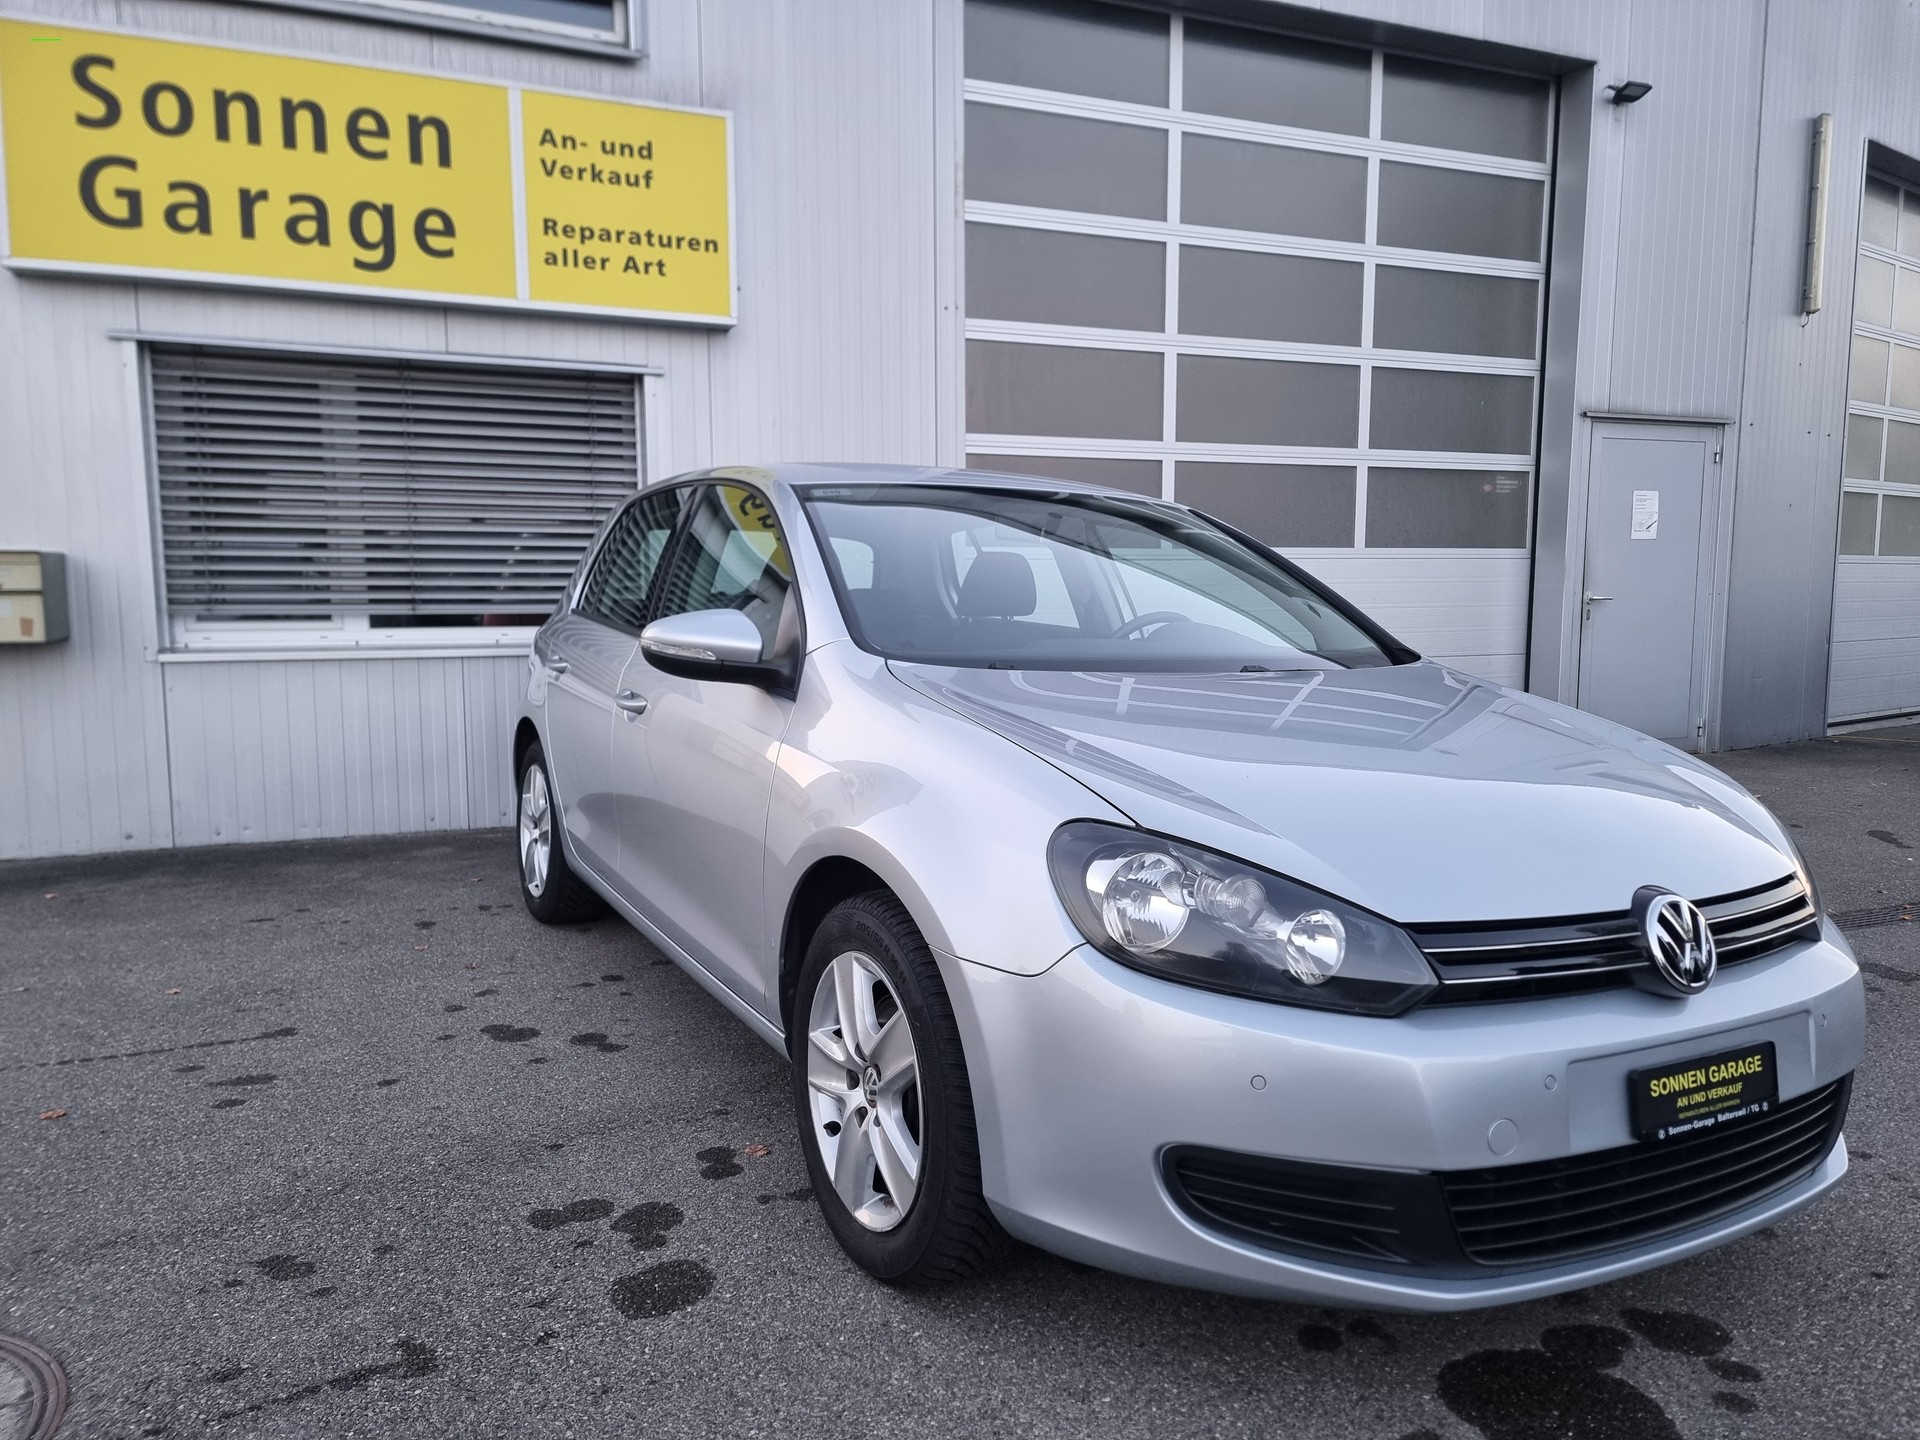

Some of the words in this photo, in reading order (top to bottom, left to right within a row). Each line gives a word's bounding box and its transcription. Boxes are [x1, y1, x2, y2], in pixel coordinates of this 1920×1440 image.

[71, 54, 453, 169] Sonnen
[539, 128, 588, 150] An-
[601, 140, 653, 160] und
[540, 158, 653, 189] Verkauf
[78, 154, 456, 273] Garage
[543, 218, 719, 253] Reparaturen
[544, 248, 610, 271] aller
[623, 256, 667, 277] Art
[855, 920, 884, 948] 205/55
[884, 944, 890, 956] R
[890, 953, 900, 971] 16
[1650, 1069, 1706, 1097] SONNEN
[1709, 1055, 1762, 1082] GARAGE
[1677, 1098, 1688, 1108] AN
[1689, 1091, 1707, 1105] UND
[1707, 1082, 1743, 1100] VERKAUF
[1668, 1118, 1715, 1135] Sonnen-Garage
[1751, 1104, 1760, 1113] TG
